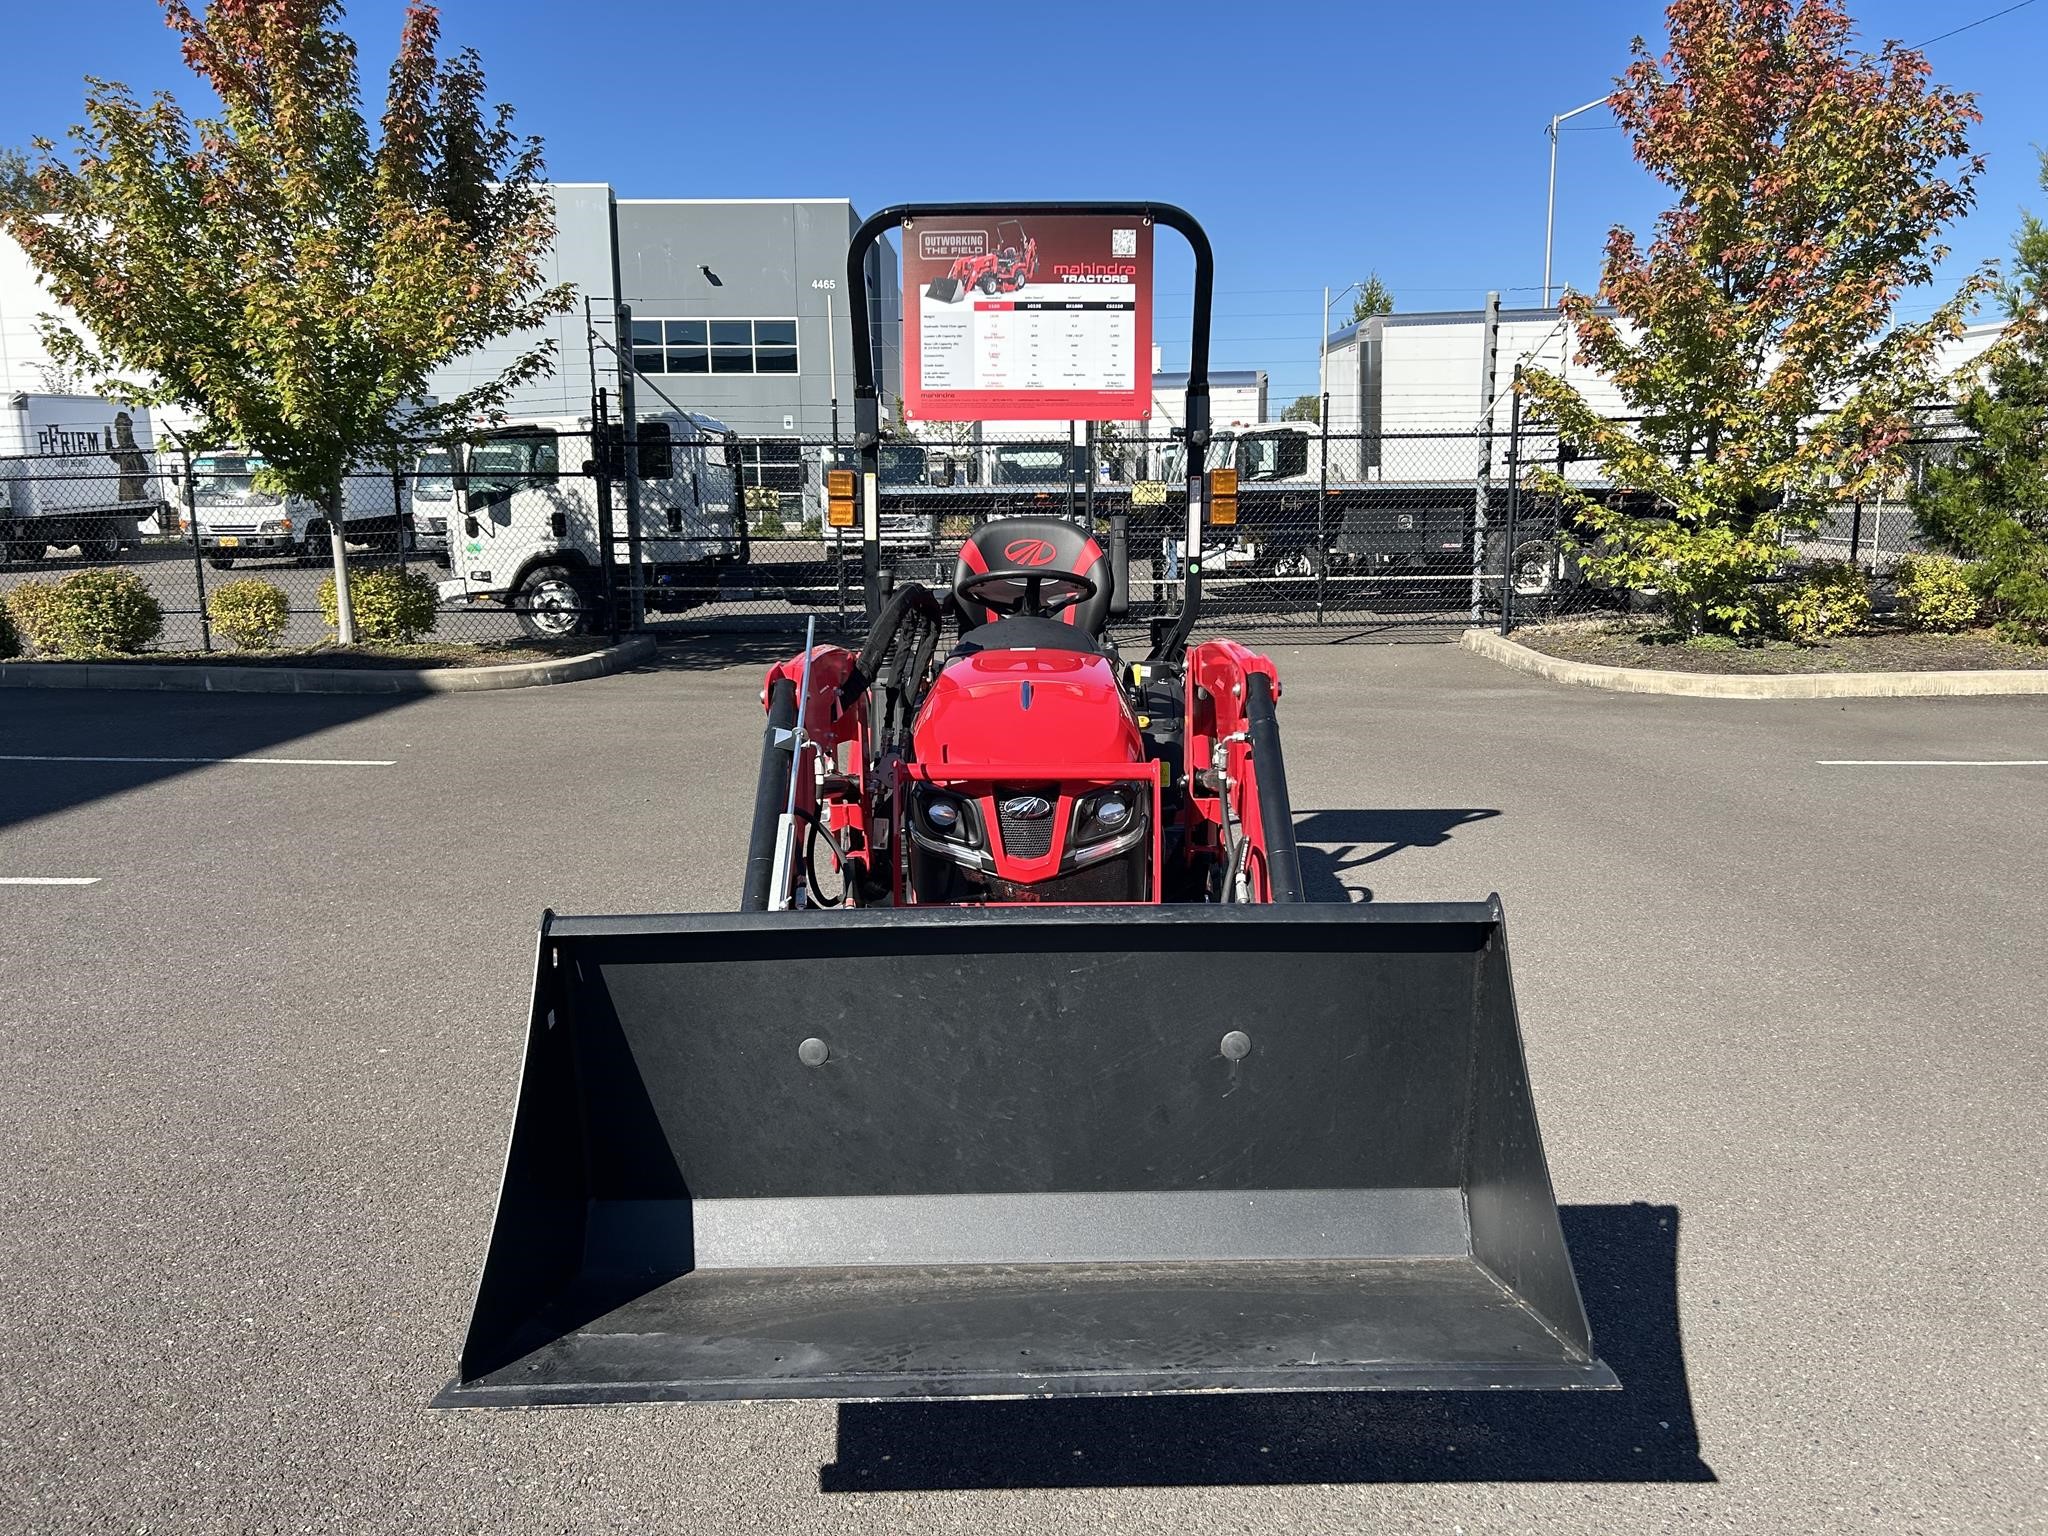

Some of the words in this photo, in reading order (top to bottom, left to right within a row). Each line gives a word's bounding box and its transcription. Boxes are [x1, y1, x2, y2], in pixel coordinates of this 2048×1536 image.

[925, 235, 983, 246] OUTWORKING
[925, 247, 947, 255] THE
[951, 247, 983, 255] FIELD
[1053, 262, 1136, 275] mahindra
[811, 279, 836, 289] 4465
[1061, 275, 1129, 283] TRACTORS
